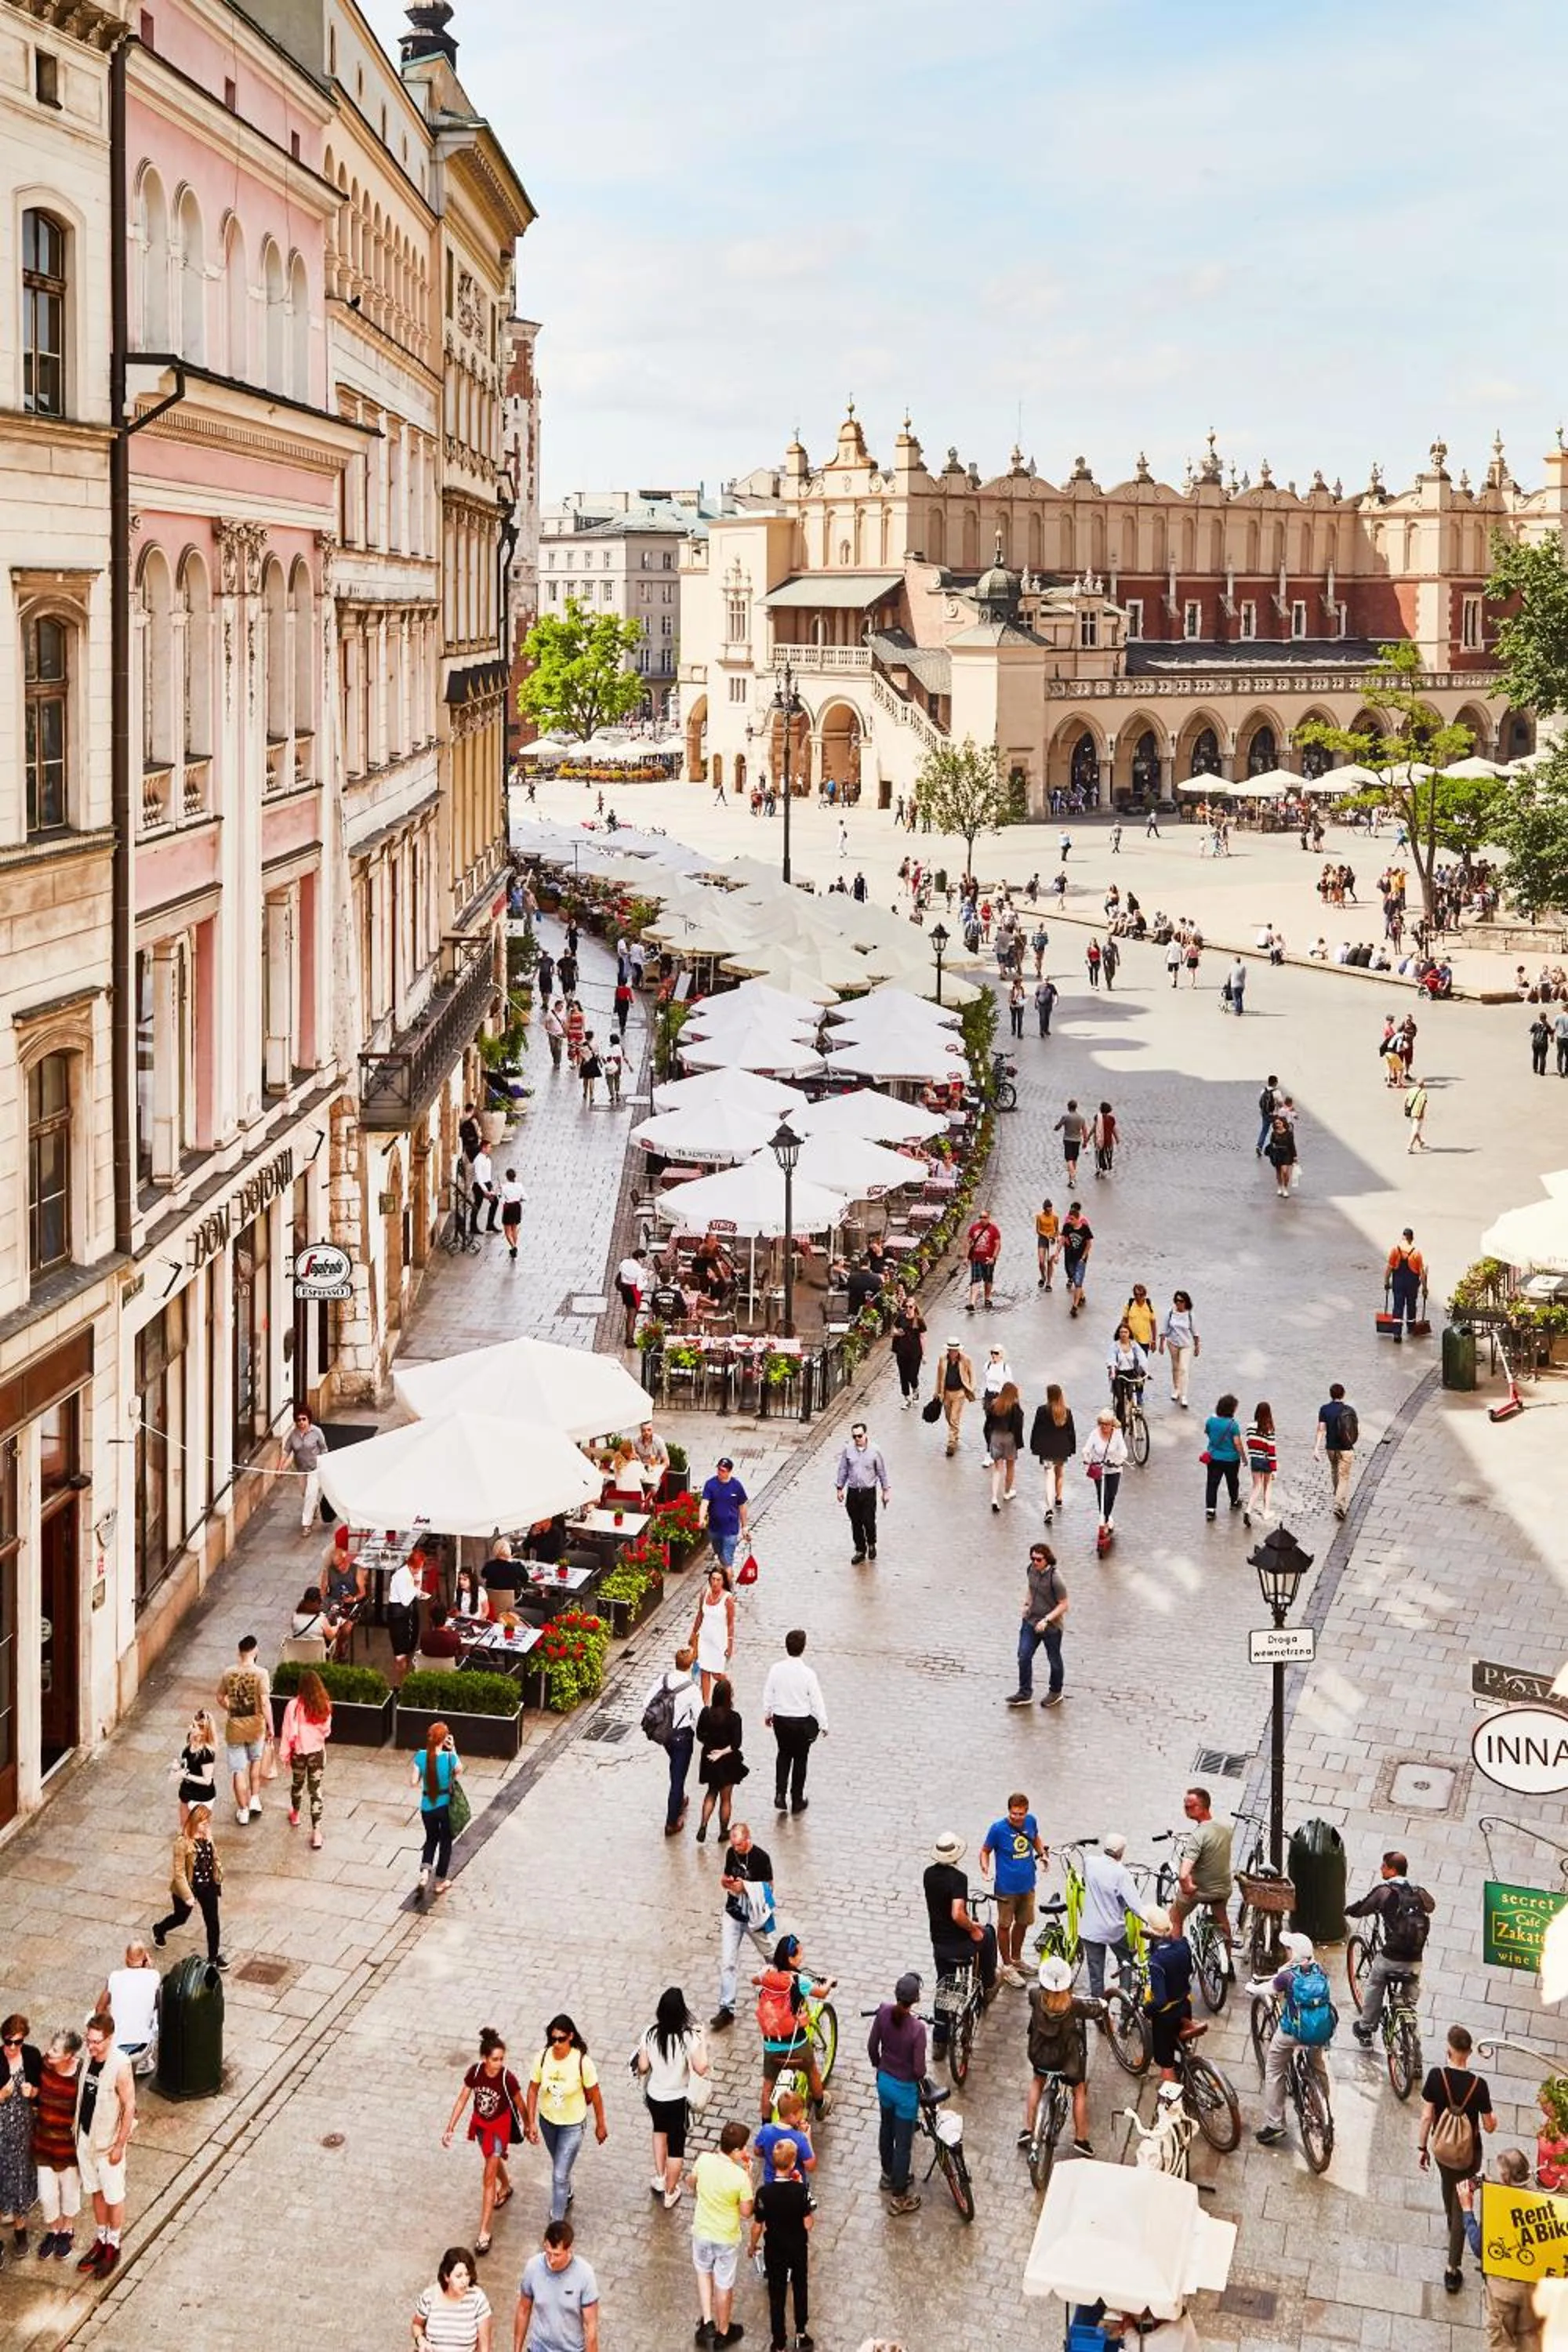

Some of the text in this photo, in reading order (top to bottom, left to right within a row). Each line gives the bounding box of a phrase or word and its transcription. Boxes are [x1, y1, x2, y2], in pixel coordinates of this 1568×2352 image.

[1268, 1635, 1298, 1645] Droga
[1487, 1735, 1568, 1767] INNA
[1501, 1893, 1555, 1911] secret
[1515, 1914, 1541, 1928] Café
[1496, 1951, 1530, 1965] wine
[1510, 2200, 1556, 2228] Rent
[1521, 2220, 1568, 2247] A Bik
